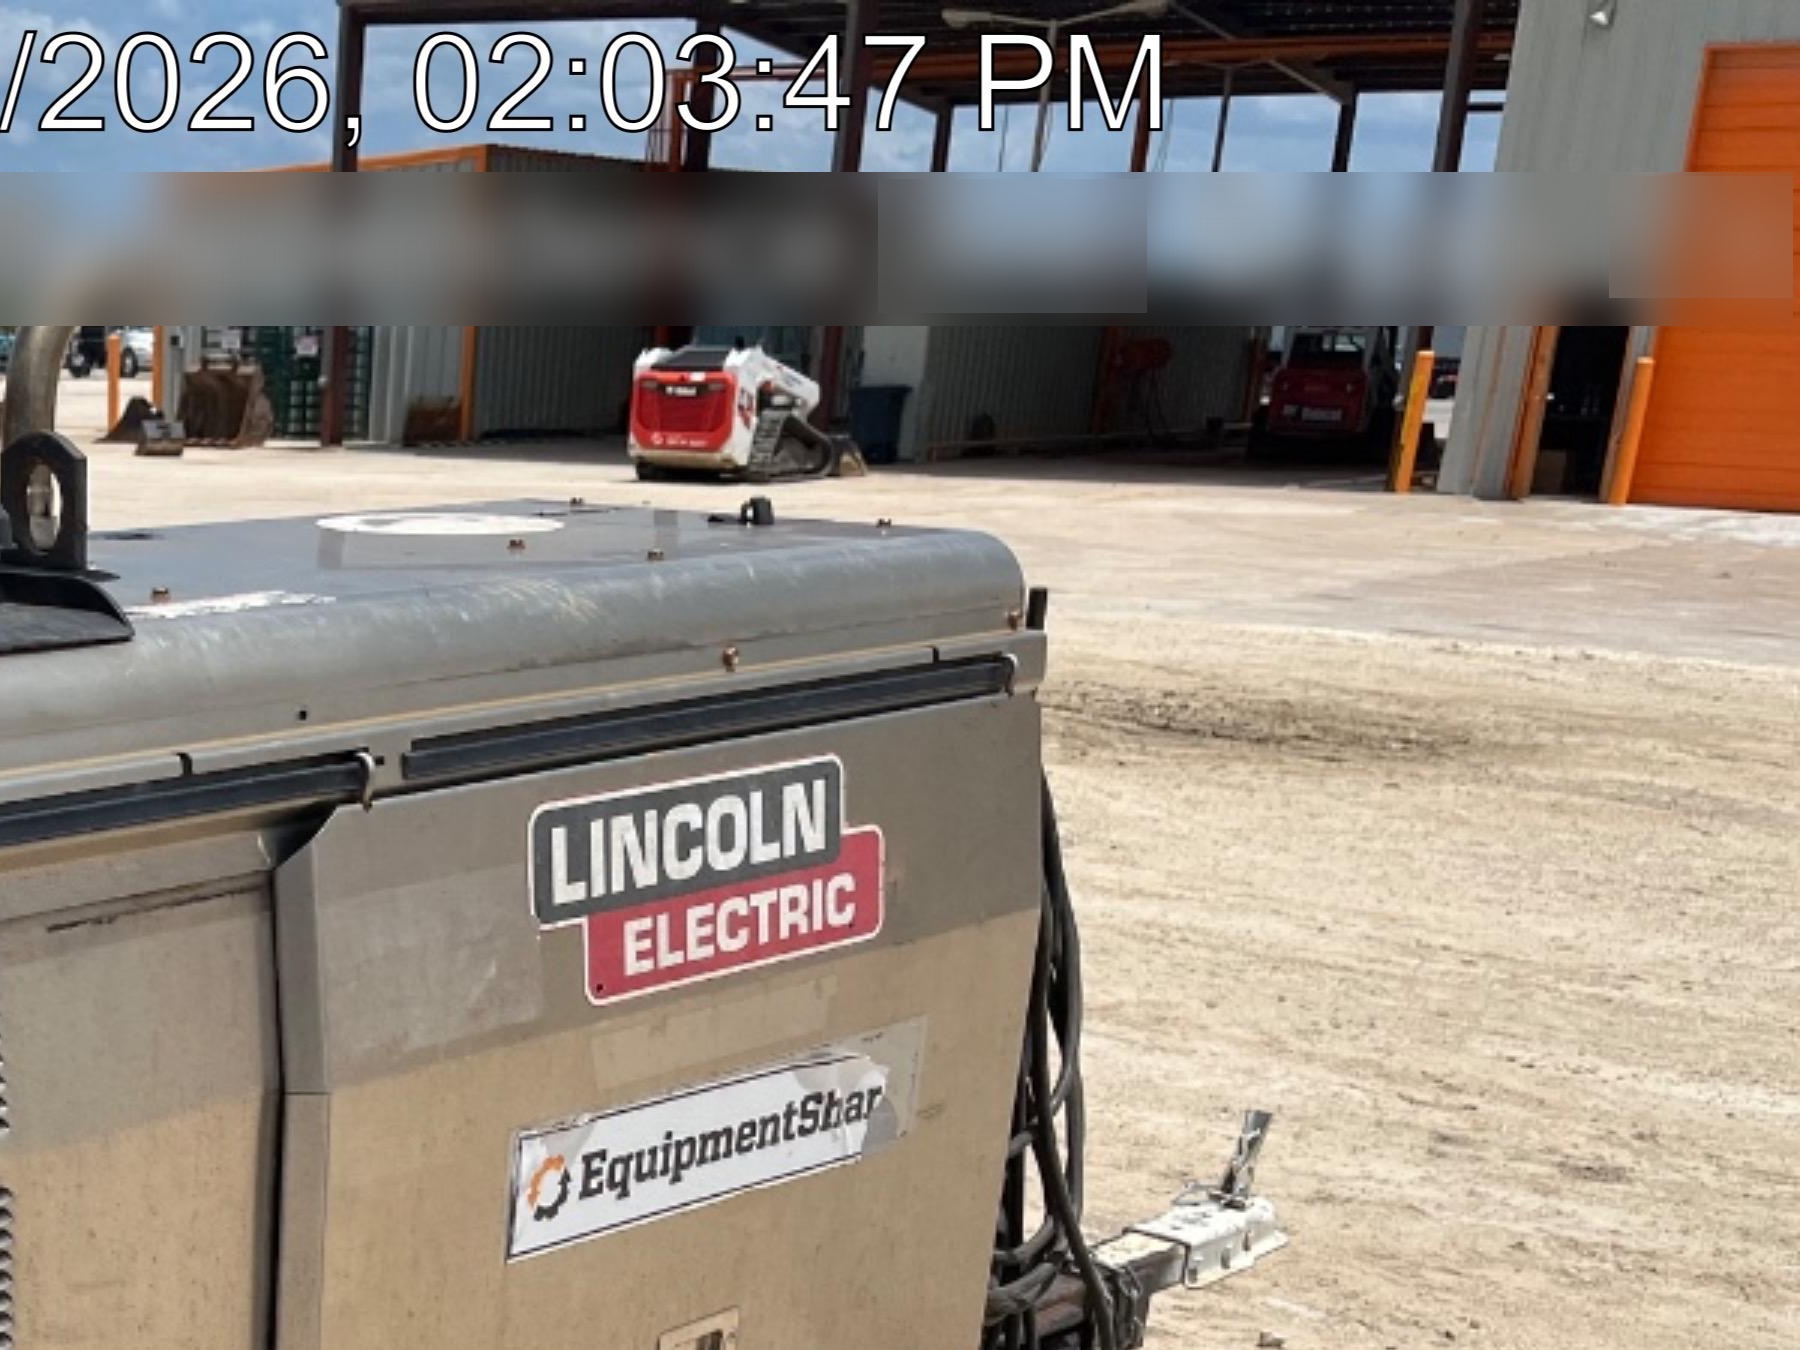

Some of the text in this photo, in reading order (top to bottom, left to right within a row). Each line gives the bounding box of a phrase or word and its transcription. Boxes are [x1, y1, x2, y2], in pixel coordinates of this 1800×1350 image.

[551, 779, 857, 977] LINCOLN ELECTRIC
[578, 1084, 882, 1200] EquipmentShar
